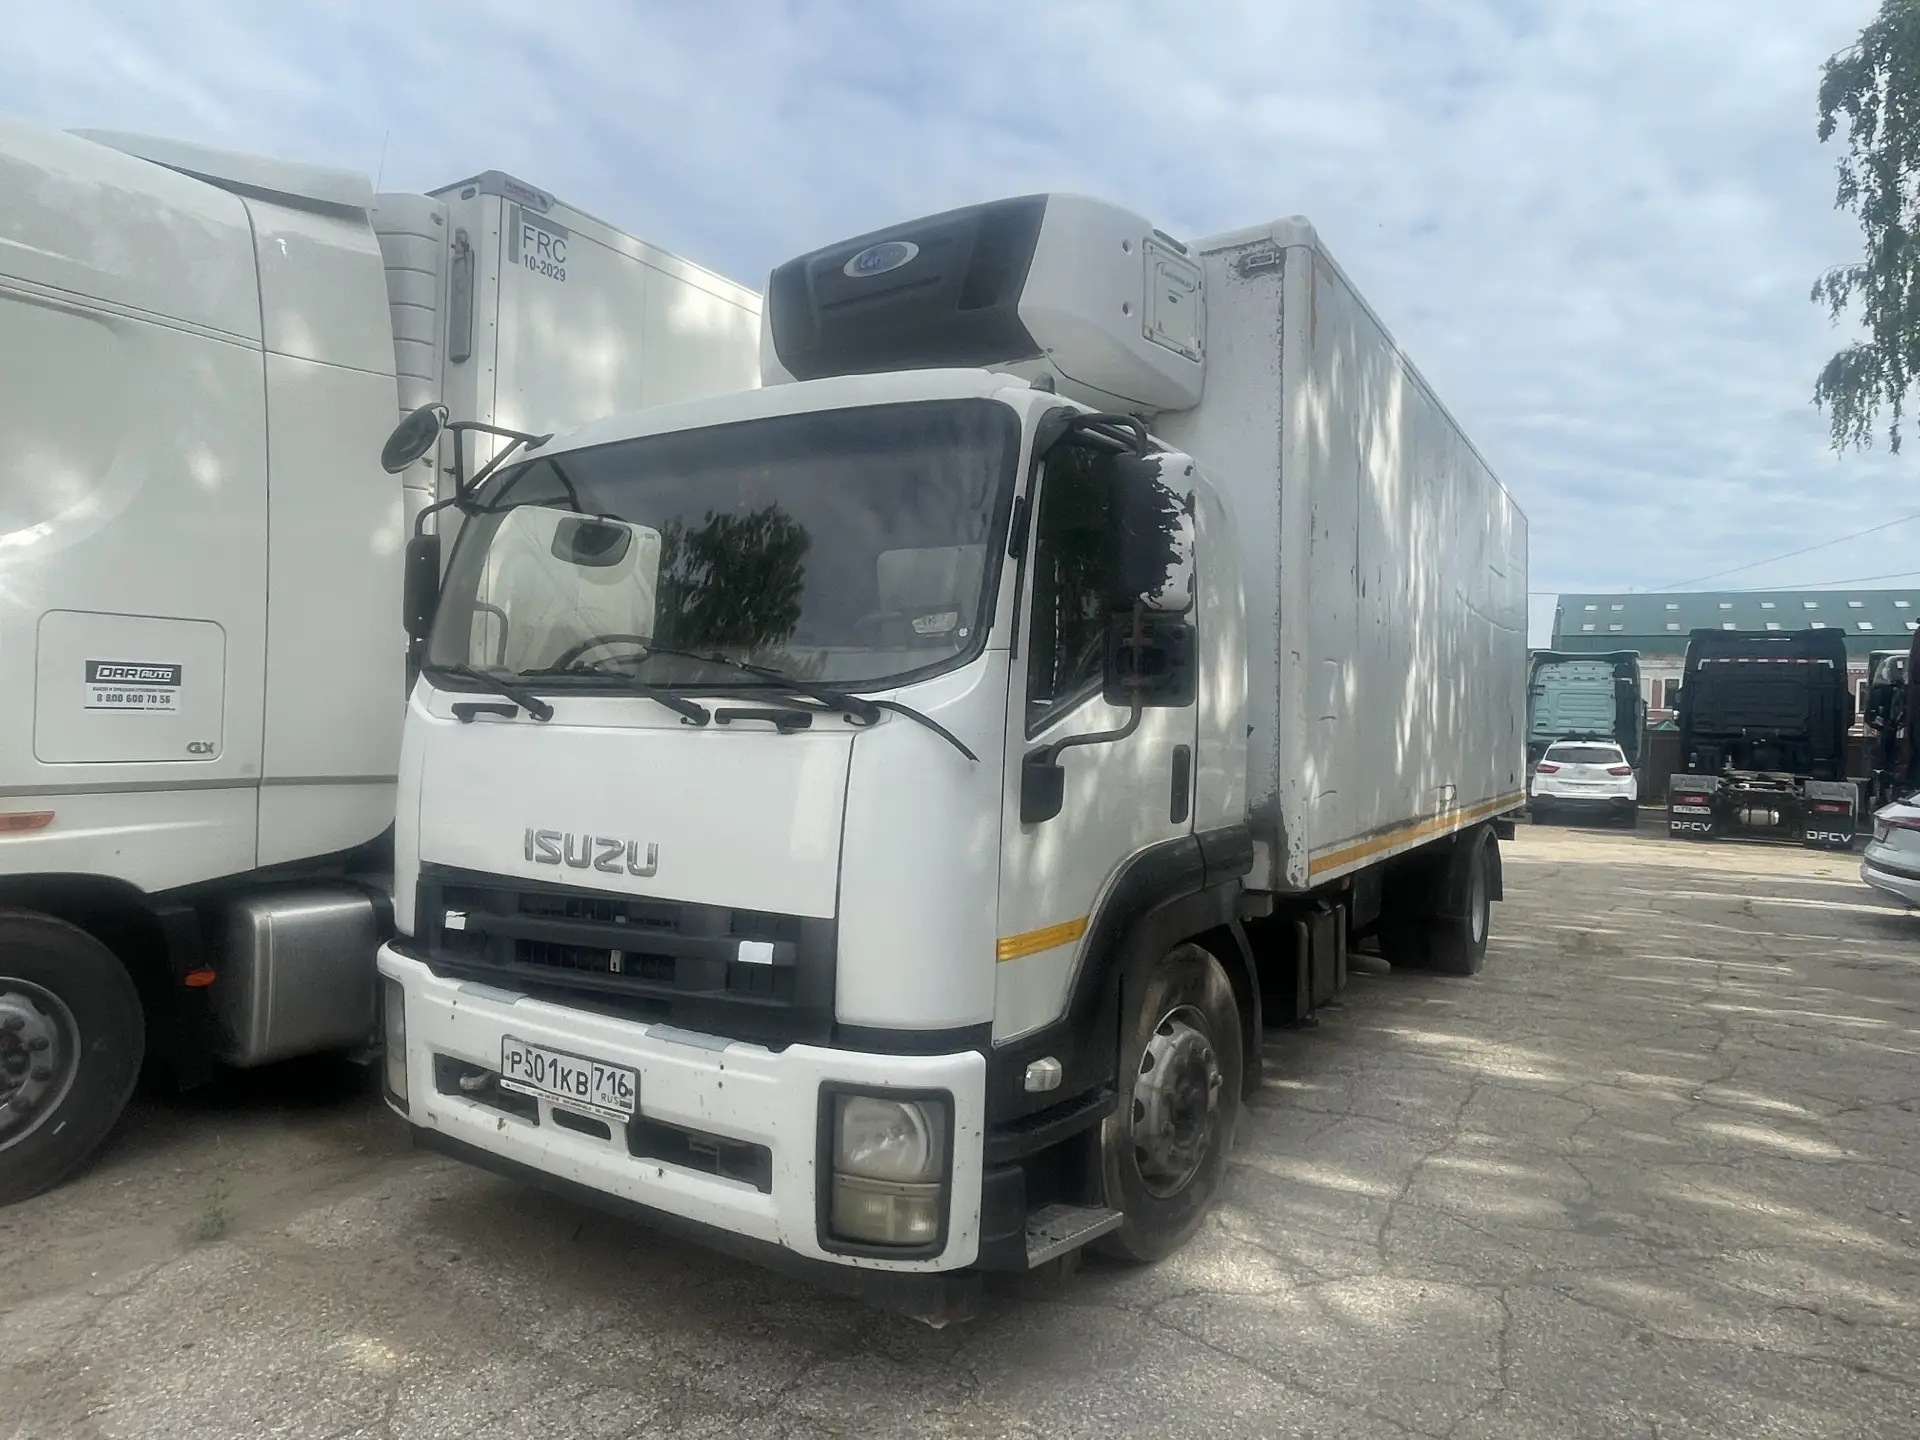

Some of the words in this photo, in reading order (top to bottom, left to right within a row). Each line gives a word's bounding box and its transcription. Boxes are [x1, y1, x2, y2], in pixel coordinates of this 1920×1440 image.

[523, 224, 566, 263] FRC
[524, 254, 567, 282] 10-2029
[99, 667, 138, 679] DAR
[140, 669, 173, 679] AUTO
[126, 694, 144, 703] 600
[146, 694, 157, 704] 70
[1671, 820, 1712, 832] DFCV
[1806, 830, 1851, 843] DFCV
[524, 827, 659, 878] ISUZU
[593, 1066, 630, 1098] 716
[600, 1092, 619, 1105] RUS
